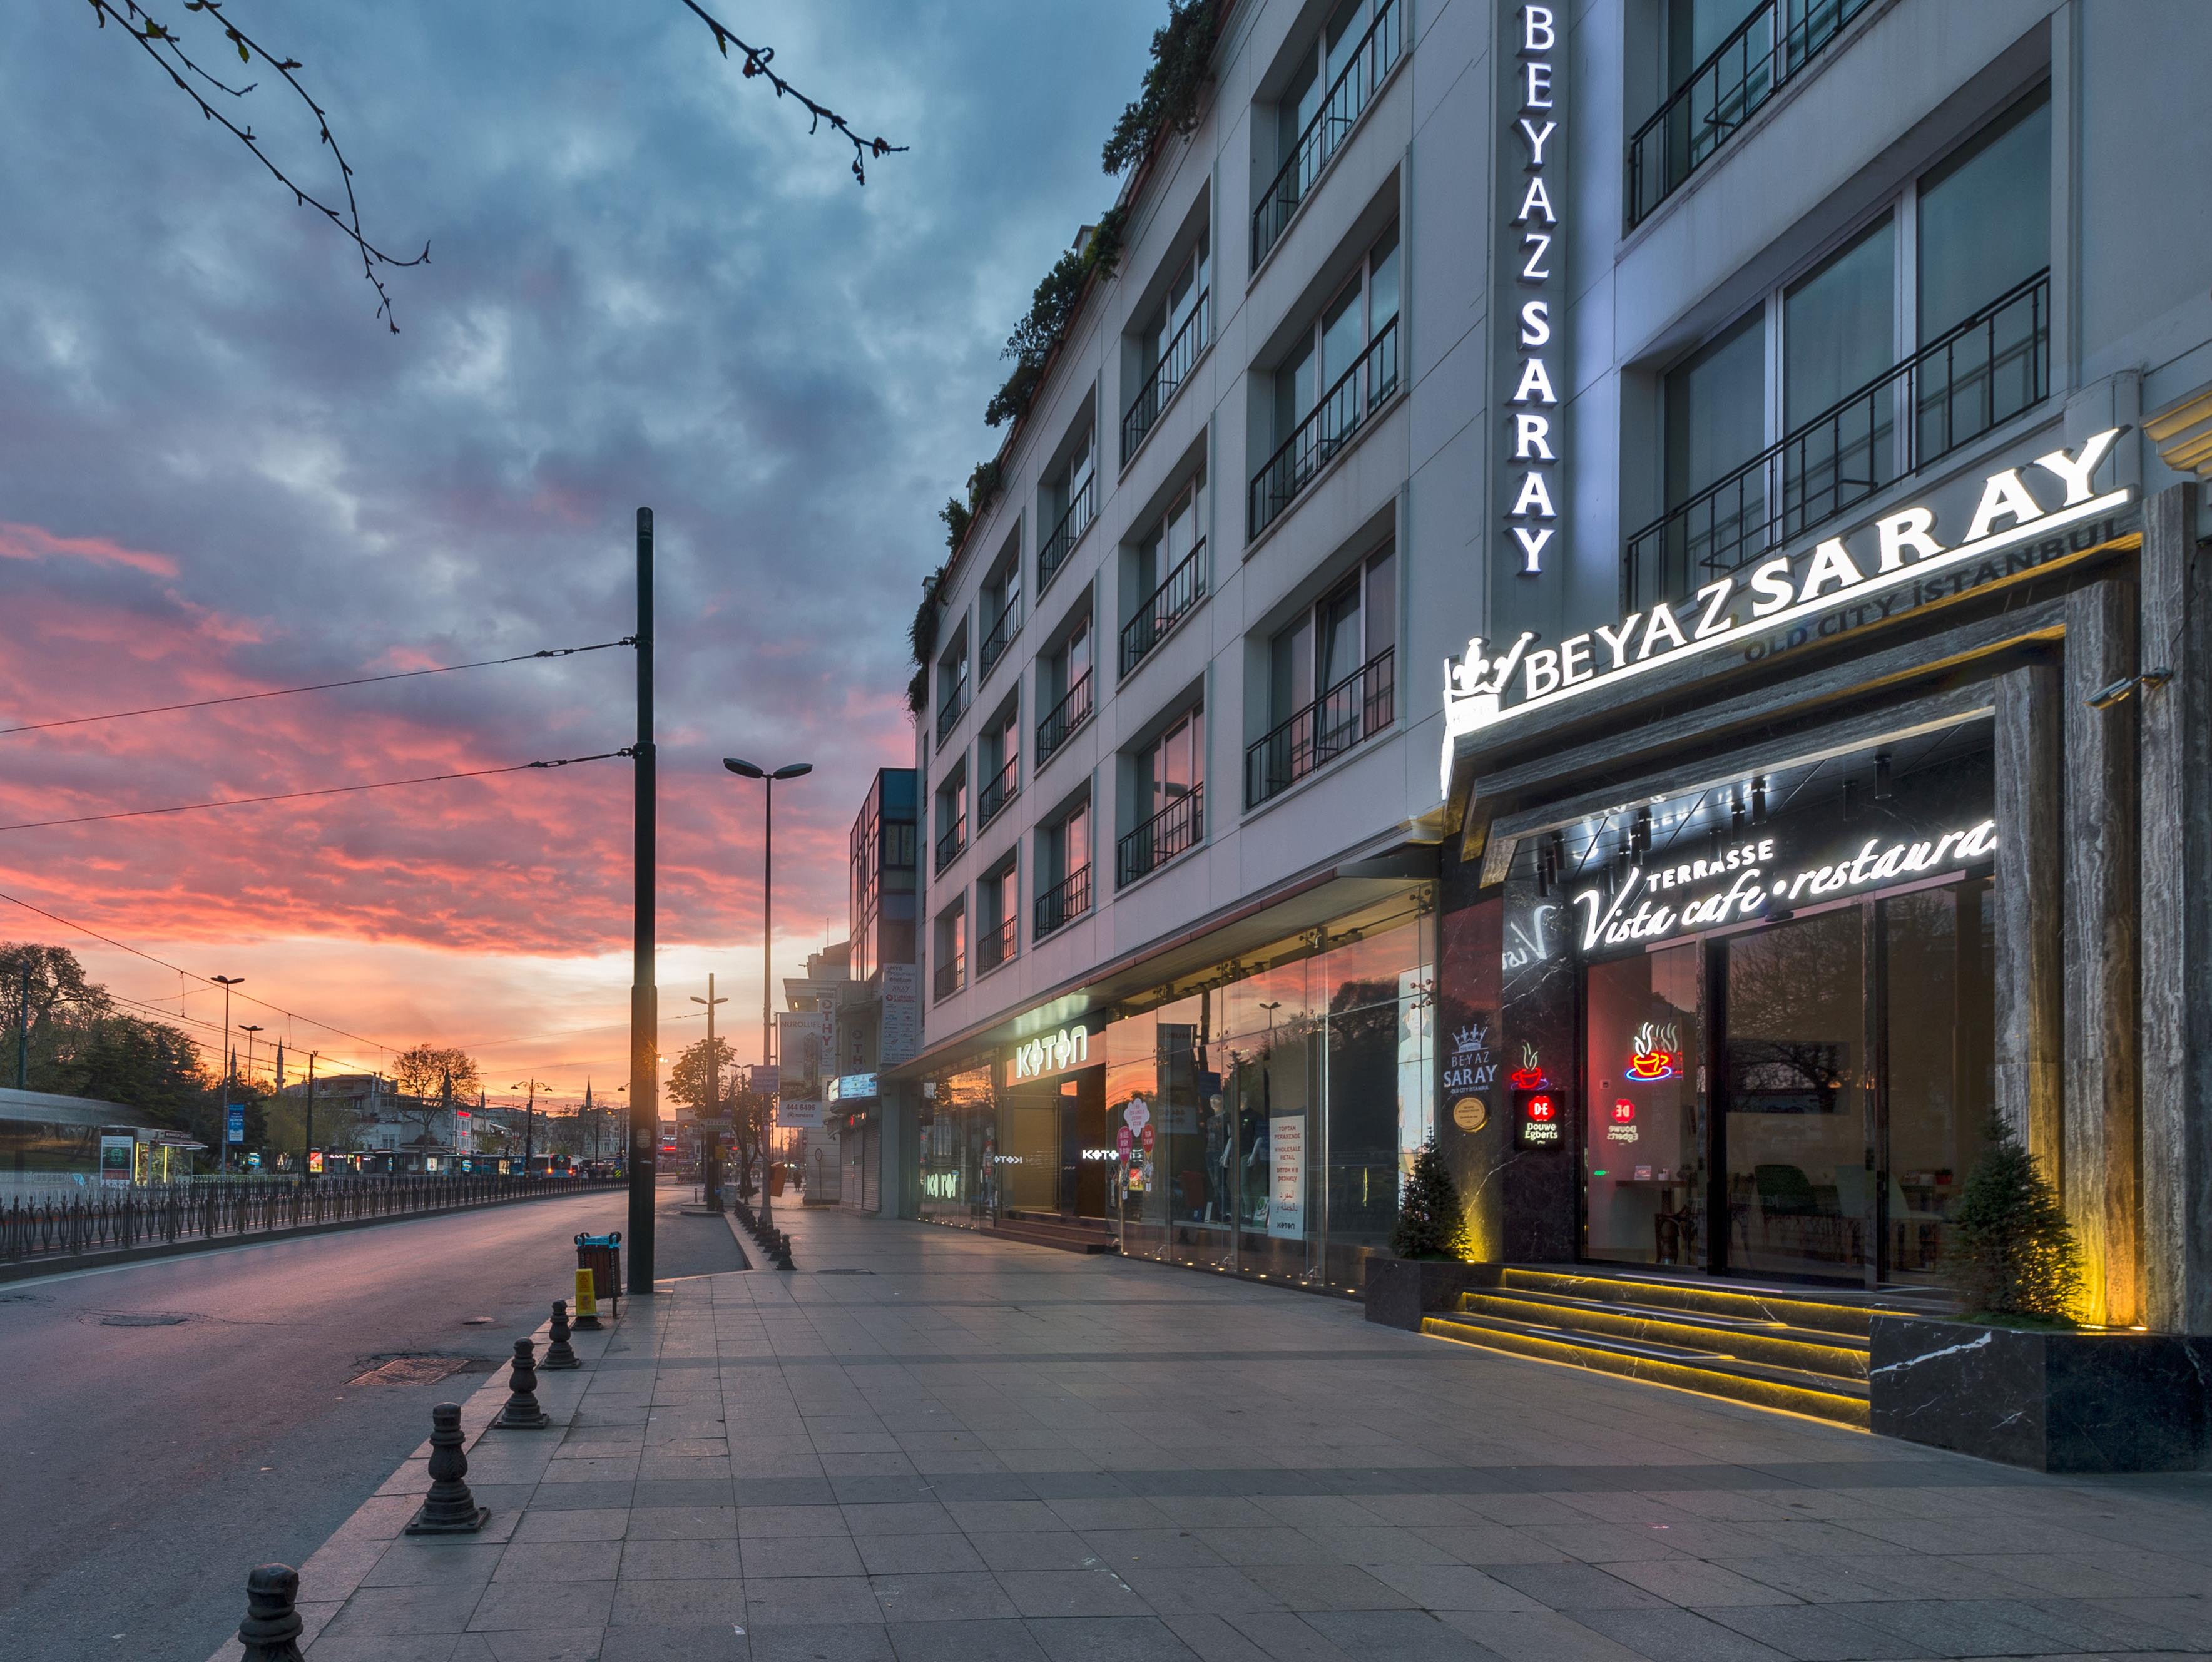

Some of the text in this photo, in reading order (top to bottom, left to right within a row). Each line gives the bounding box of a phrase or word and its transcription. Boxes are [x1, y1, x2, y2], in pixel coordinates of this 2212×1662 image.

[1511, 4, 1557, 574] BEYAZ SARAY
[1524, 428, 2123, 700] BEYAZ SARAY
[1743, 627, 1808, 663] OLD
[1817, 594, 1895, 638] CITY
[1647, 839, 1773, 892] TERRASSE
[1574, 819, 1997, 950] Vista cafe restaura
[822, 1011, 832, 1046] THY
[1443, 1064, 1498, 1088] SARAY
[1451, 1051, 1489, 1067] BEYAZ
[1524, 1131, 1558, 1141] Egberts
[1527, 1123, 1557, 1131] Douwe
[1083, 1150, 1119, 1160] KOTO
